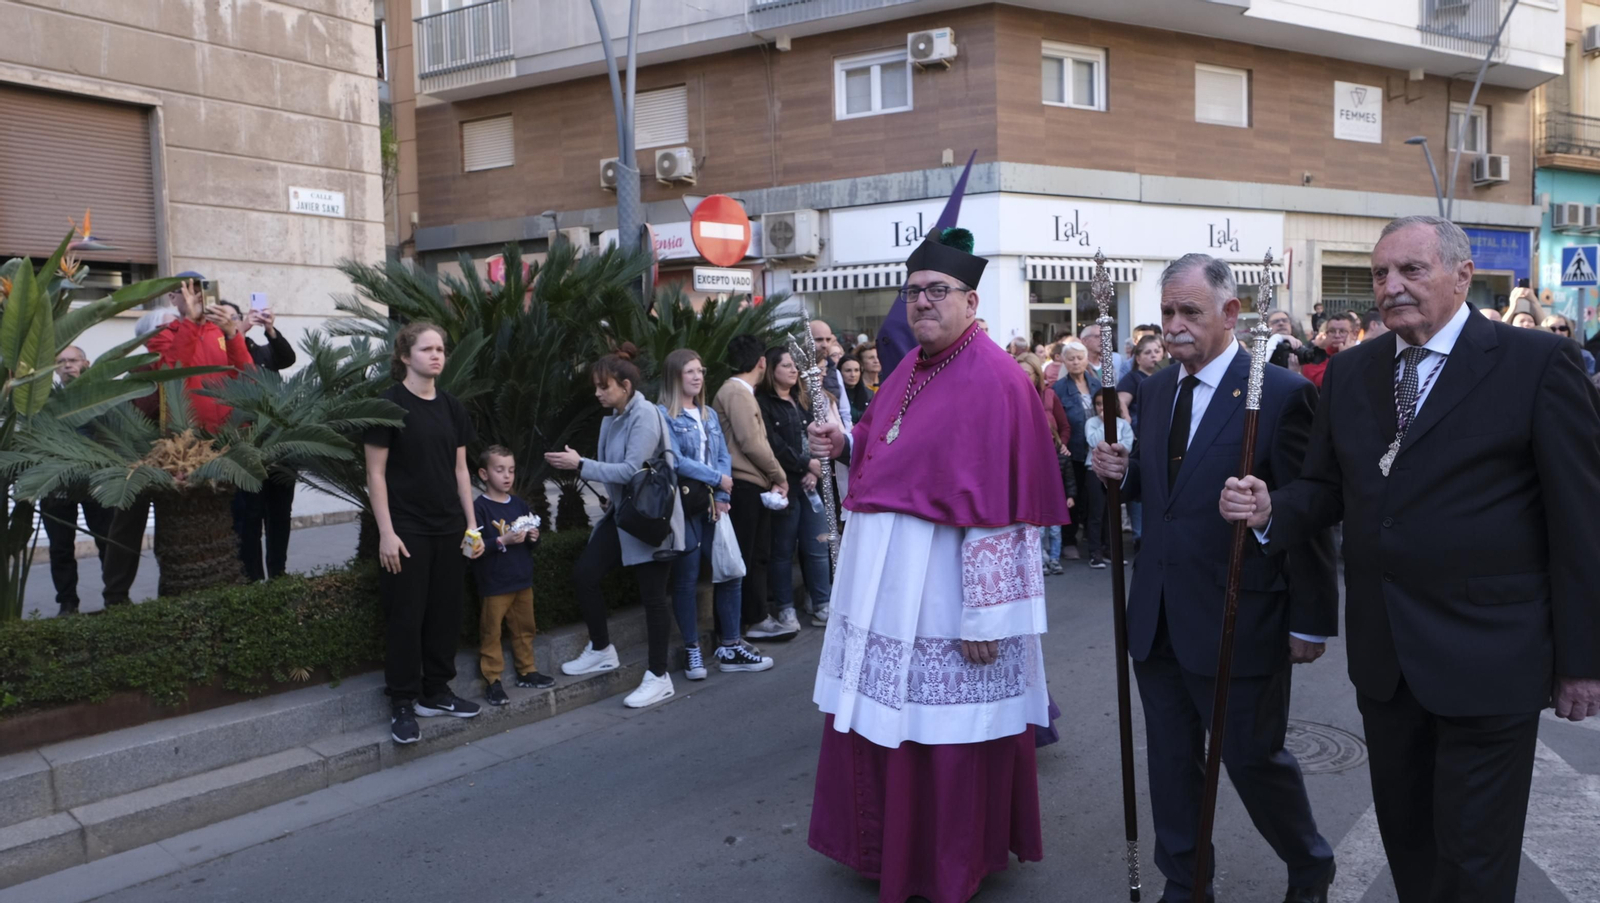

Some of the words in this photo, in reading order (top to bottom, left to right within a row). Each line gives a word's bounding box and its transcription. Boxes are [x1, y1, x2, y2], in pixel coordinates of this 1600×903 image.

[1340, 109, 1377, 123] FEMMES
[310, 192, 333, 200] CALLE
[296, 201, 320, 212] JAVIER
[322, 204, 340, 214] SANZ
[891, 211, 934, 248] Lal
[1052, 209, 1090, 247] Lalá
[1207, 217, 1239, 252] Lalá
[697, 275, 730, 286] EXCEPTO
[731, 276, 751, 287] VADO
